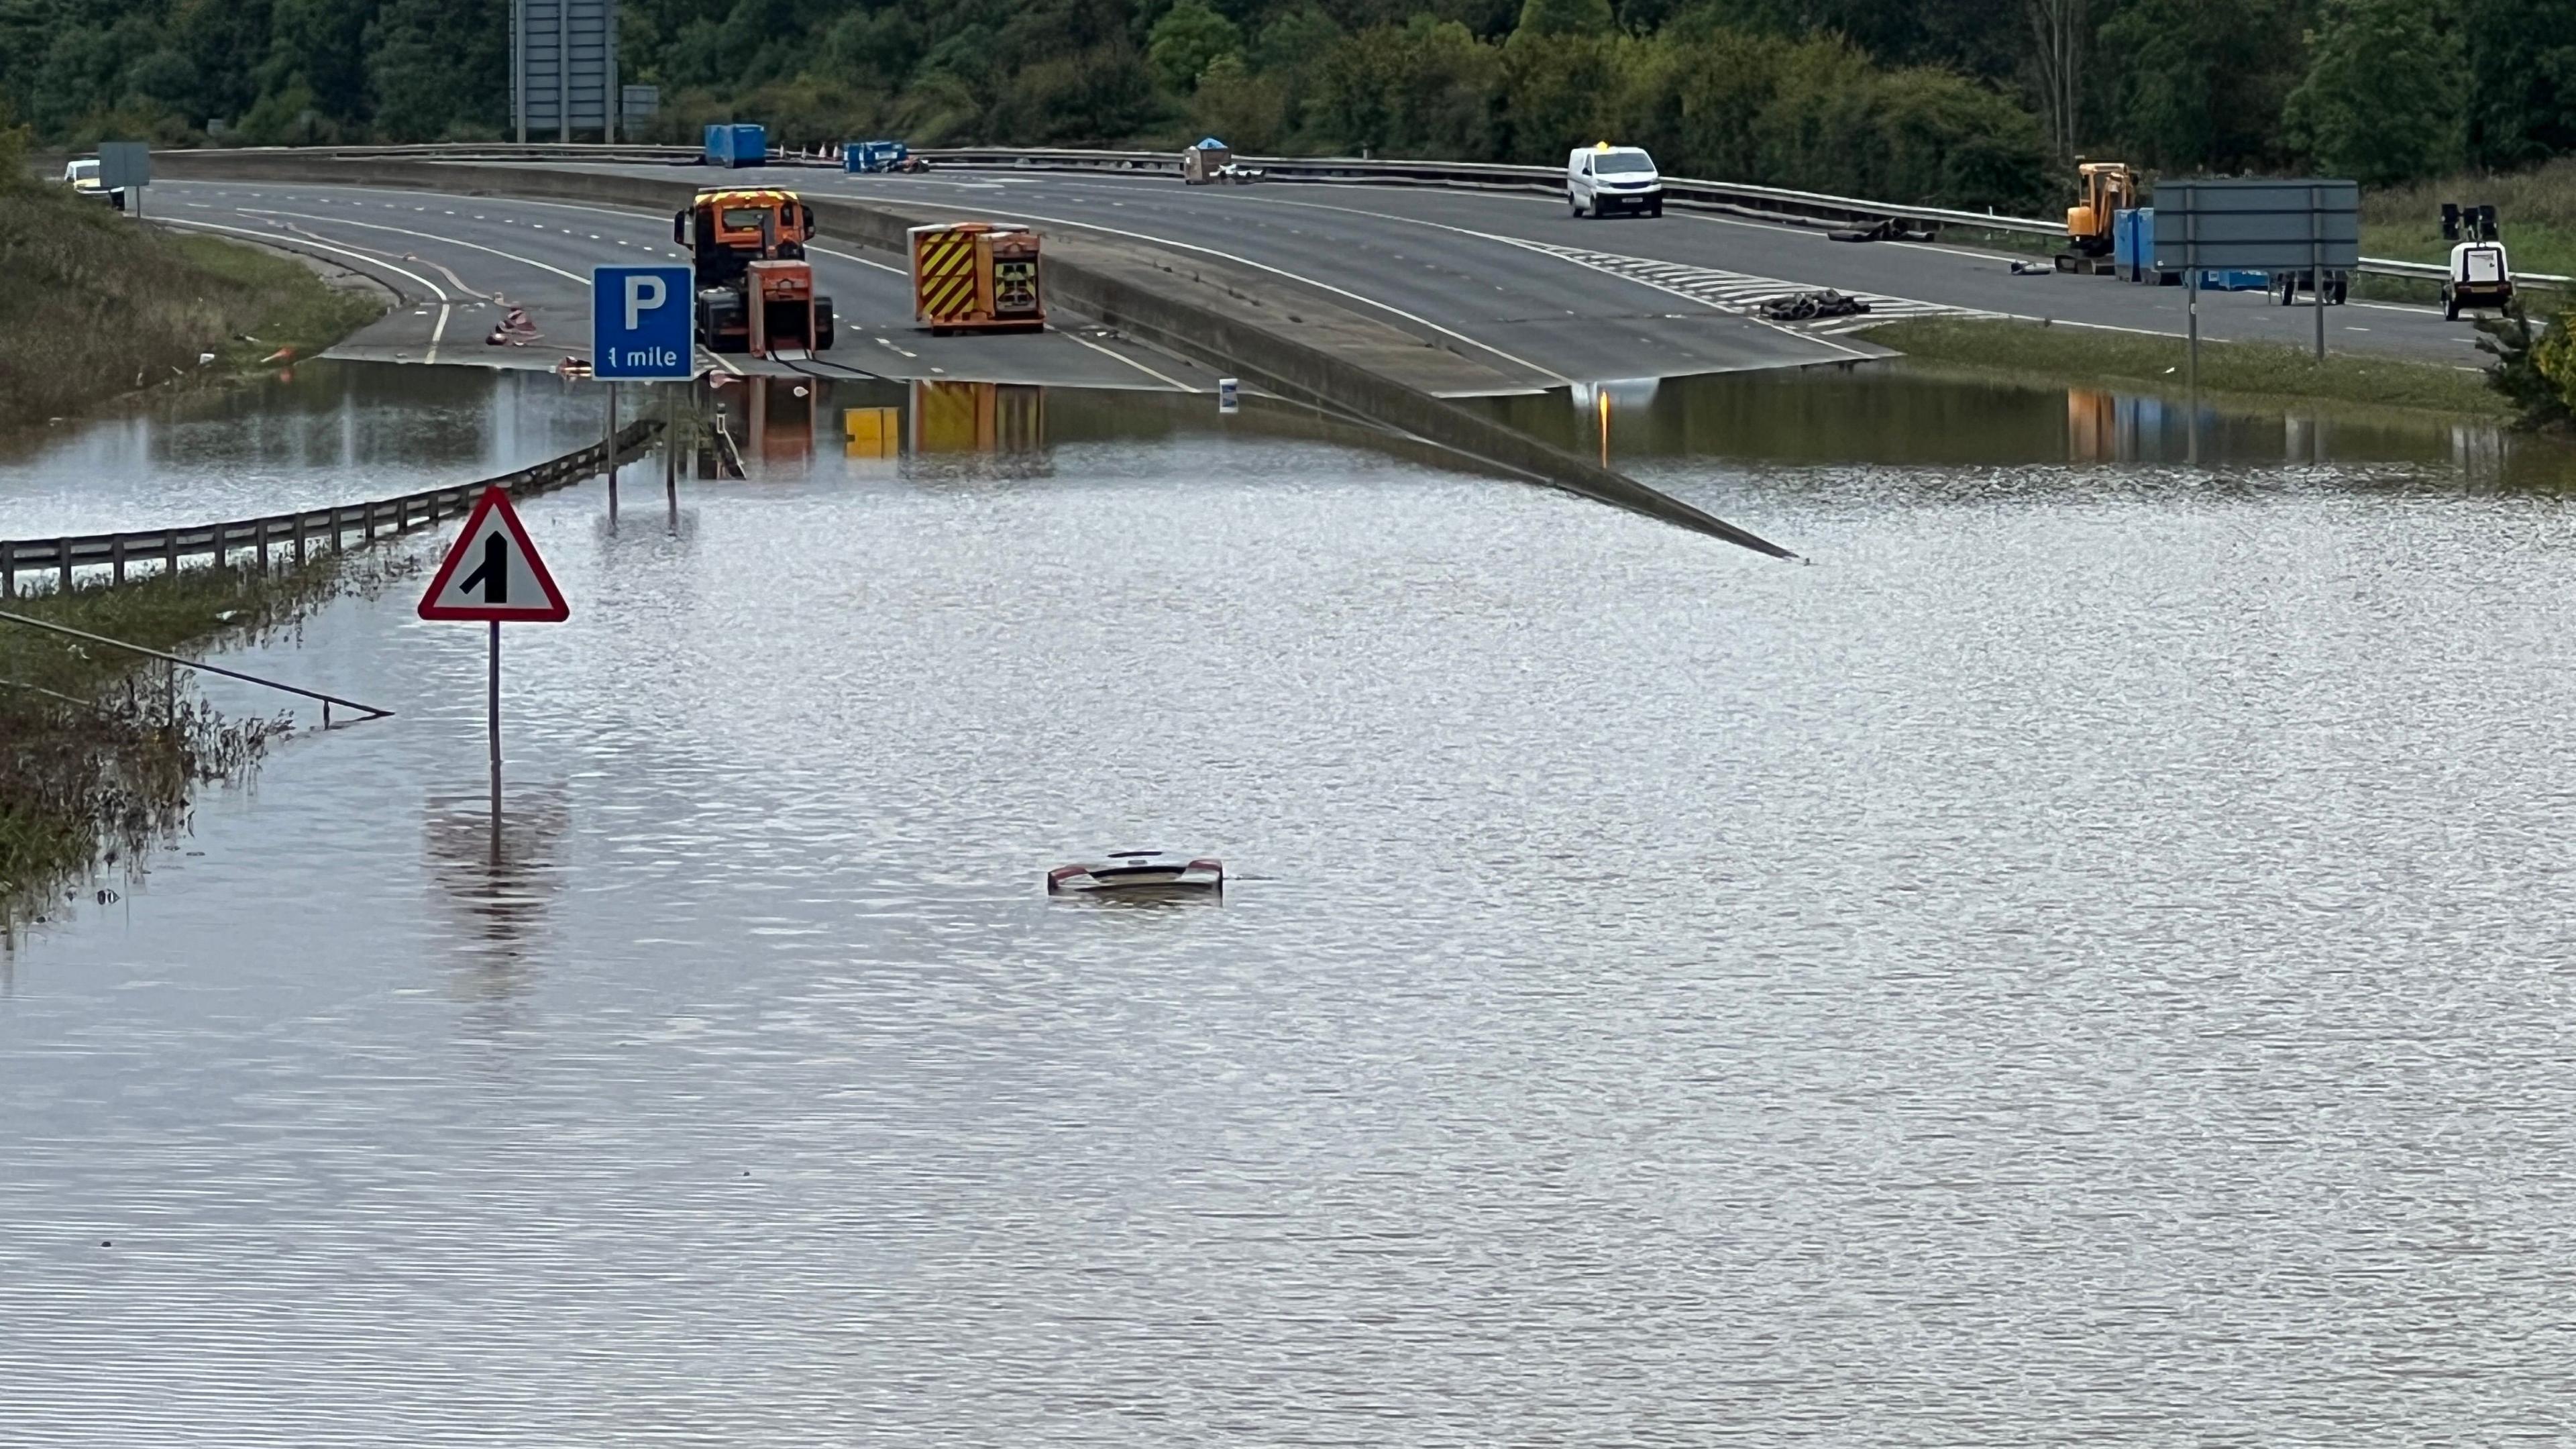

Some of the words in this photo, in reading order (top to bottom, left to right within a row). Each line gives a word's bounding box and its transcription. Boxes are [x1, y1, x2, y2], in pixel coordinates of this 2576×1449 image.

[625, 275, 666, 330] P
[608, 347, 617, 368] 1
[627, 346, 677, 367] mile
